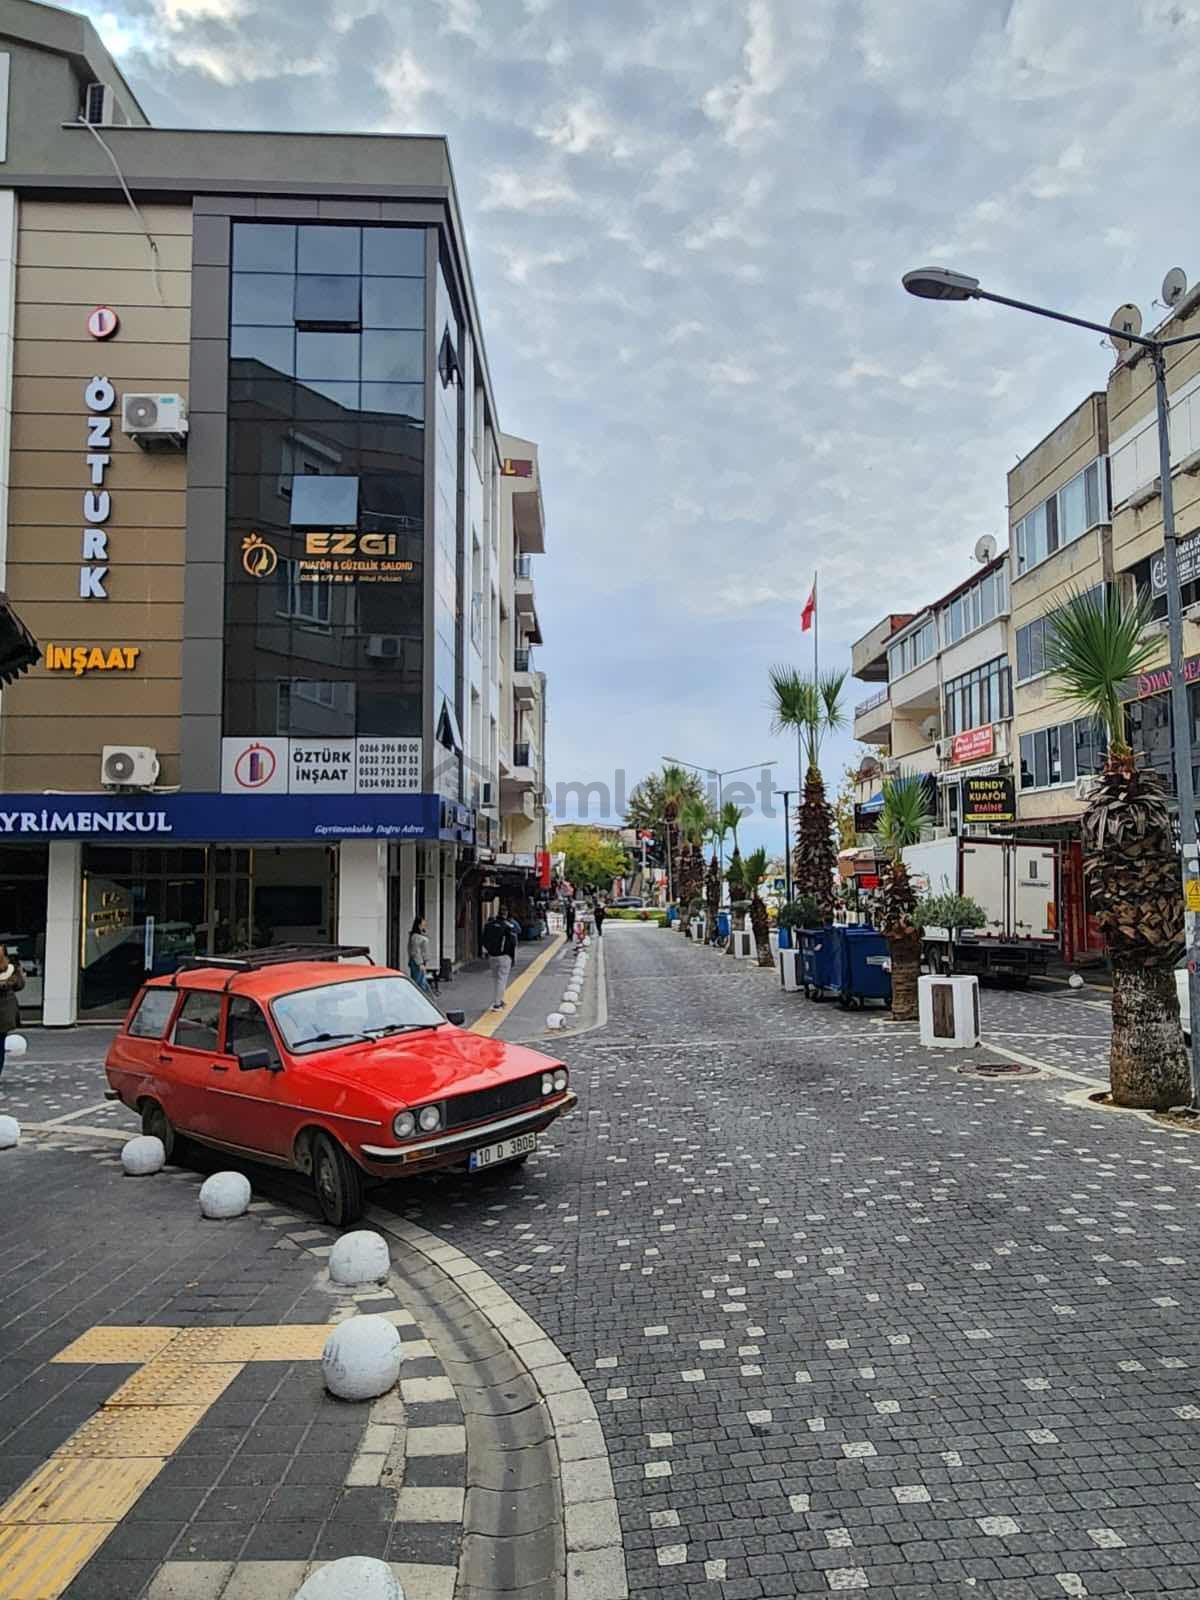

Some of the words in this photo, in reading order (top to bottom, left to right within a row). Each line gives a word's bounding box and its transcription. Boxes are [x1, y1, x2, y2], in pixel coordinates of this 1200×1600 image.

[46, 642, 139, 676] İNŞAAT
[293, 747, 352, 763] ÖZTÜRK
[295, 765, 348, 784] İNŞAAT
[969, 781, 1004, 791] TRENDY
[0, 809, 173, 832] YRİMENKUL
